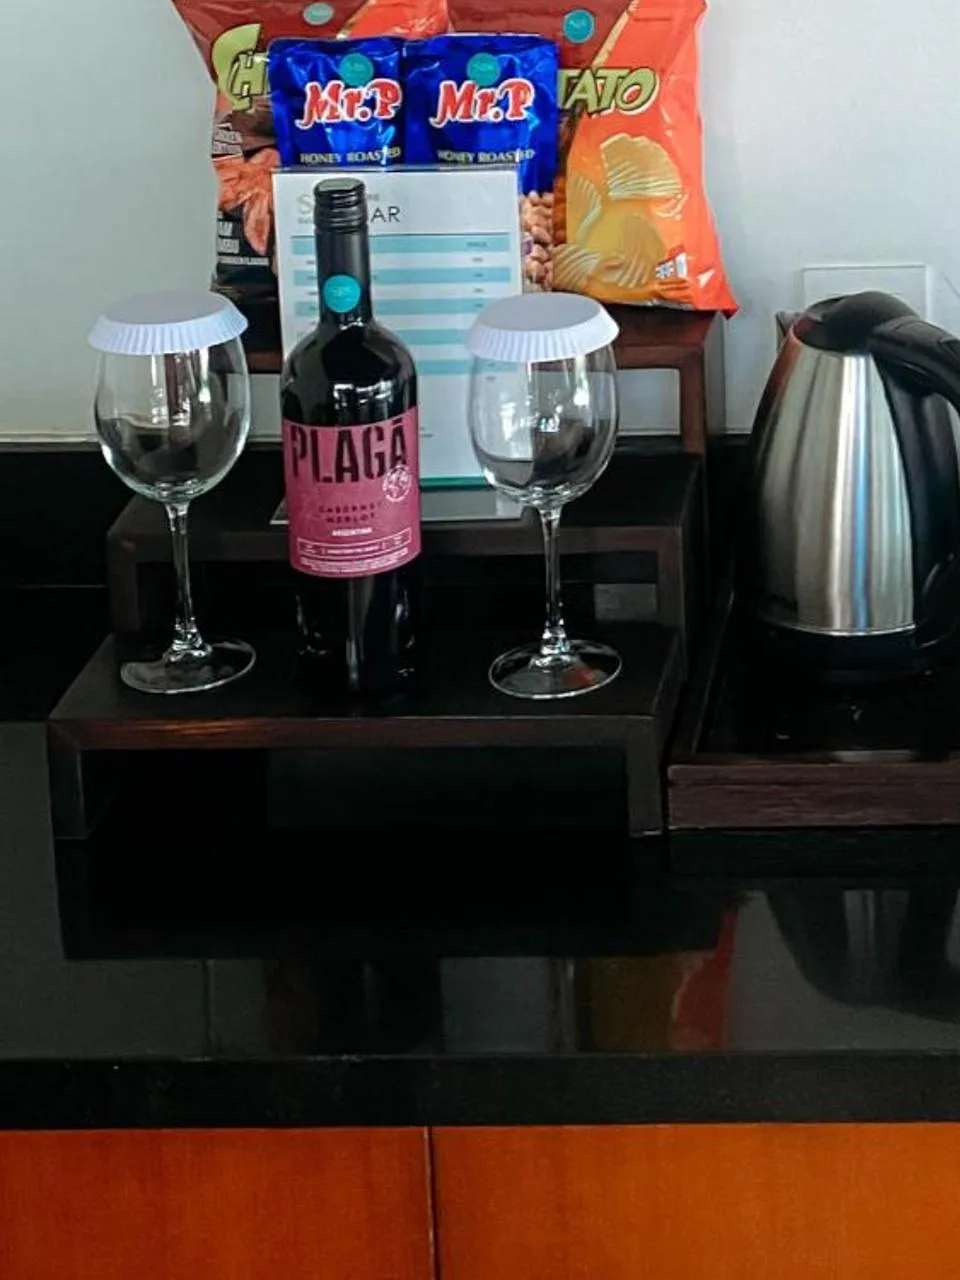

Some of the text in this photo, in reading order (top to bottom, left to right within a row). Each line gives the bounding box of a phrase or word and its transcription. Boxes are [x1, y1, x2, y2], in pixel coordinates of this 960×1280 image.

[295, 78, 402, 129] Mr.P
[429, 78, 535, 128] Mr.P
[300, 151, 342, 164] HONEY
[437, 149, 474, 163] HONEY
